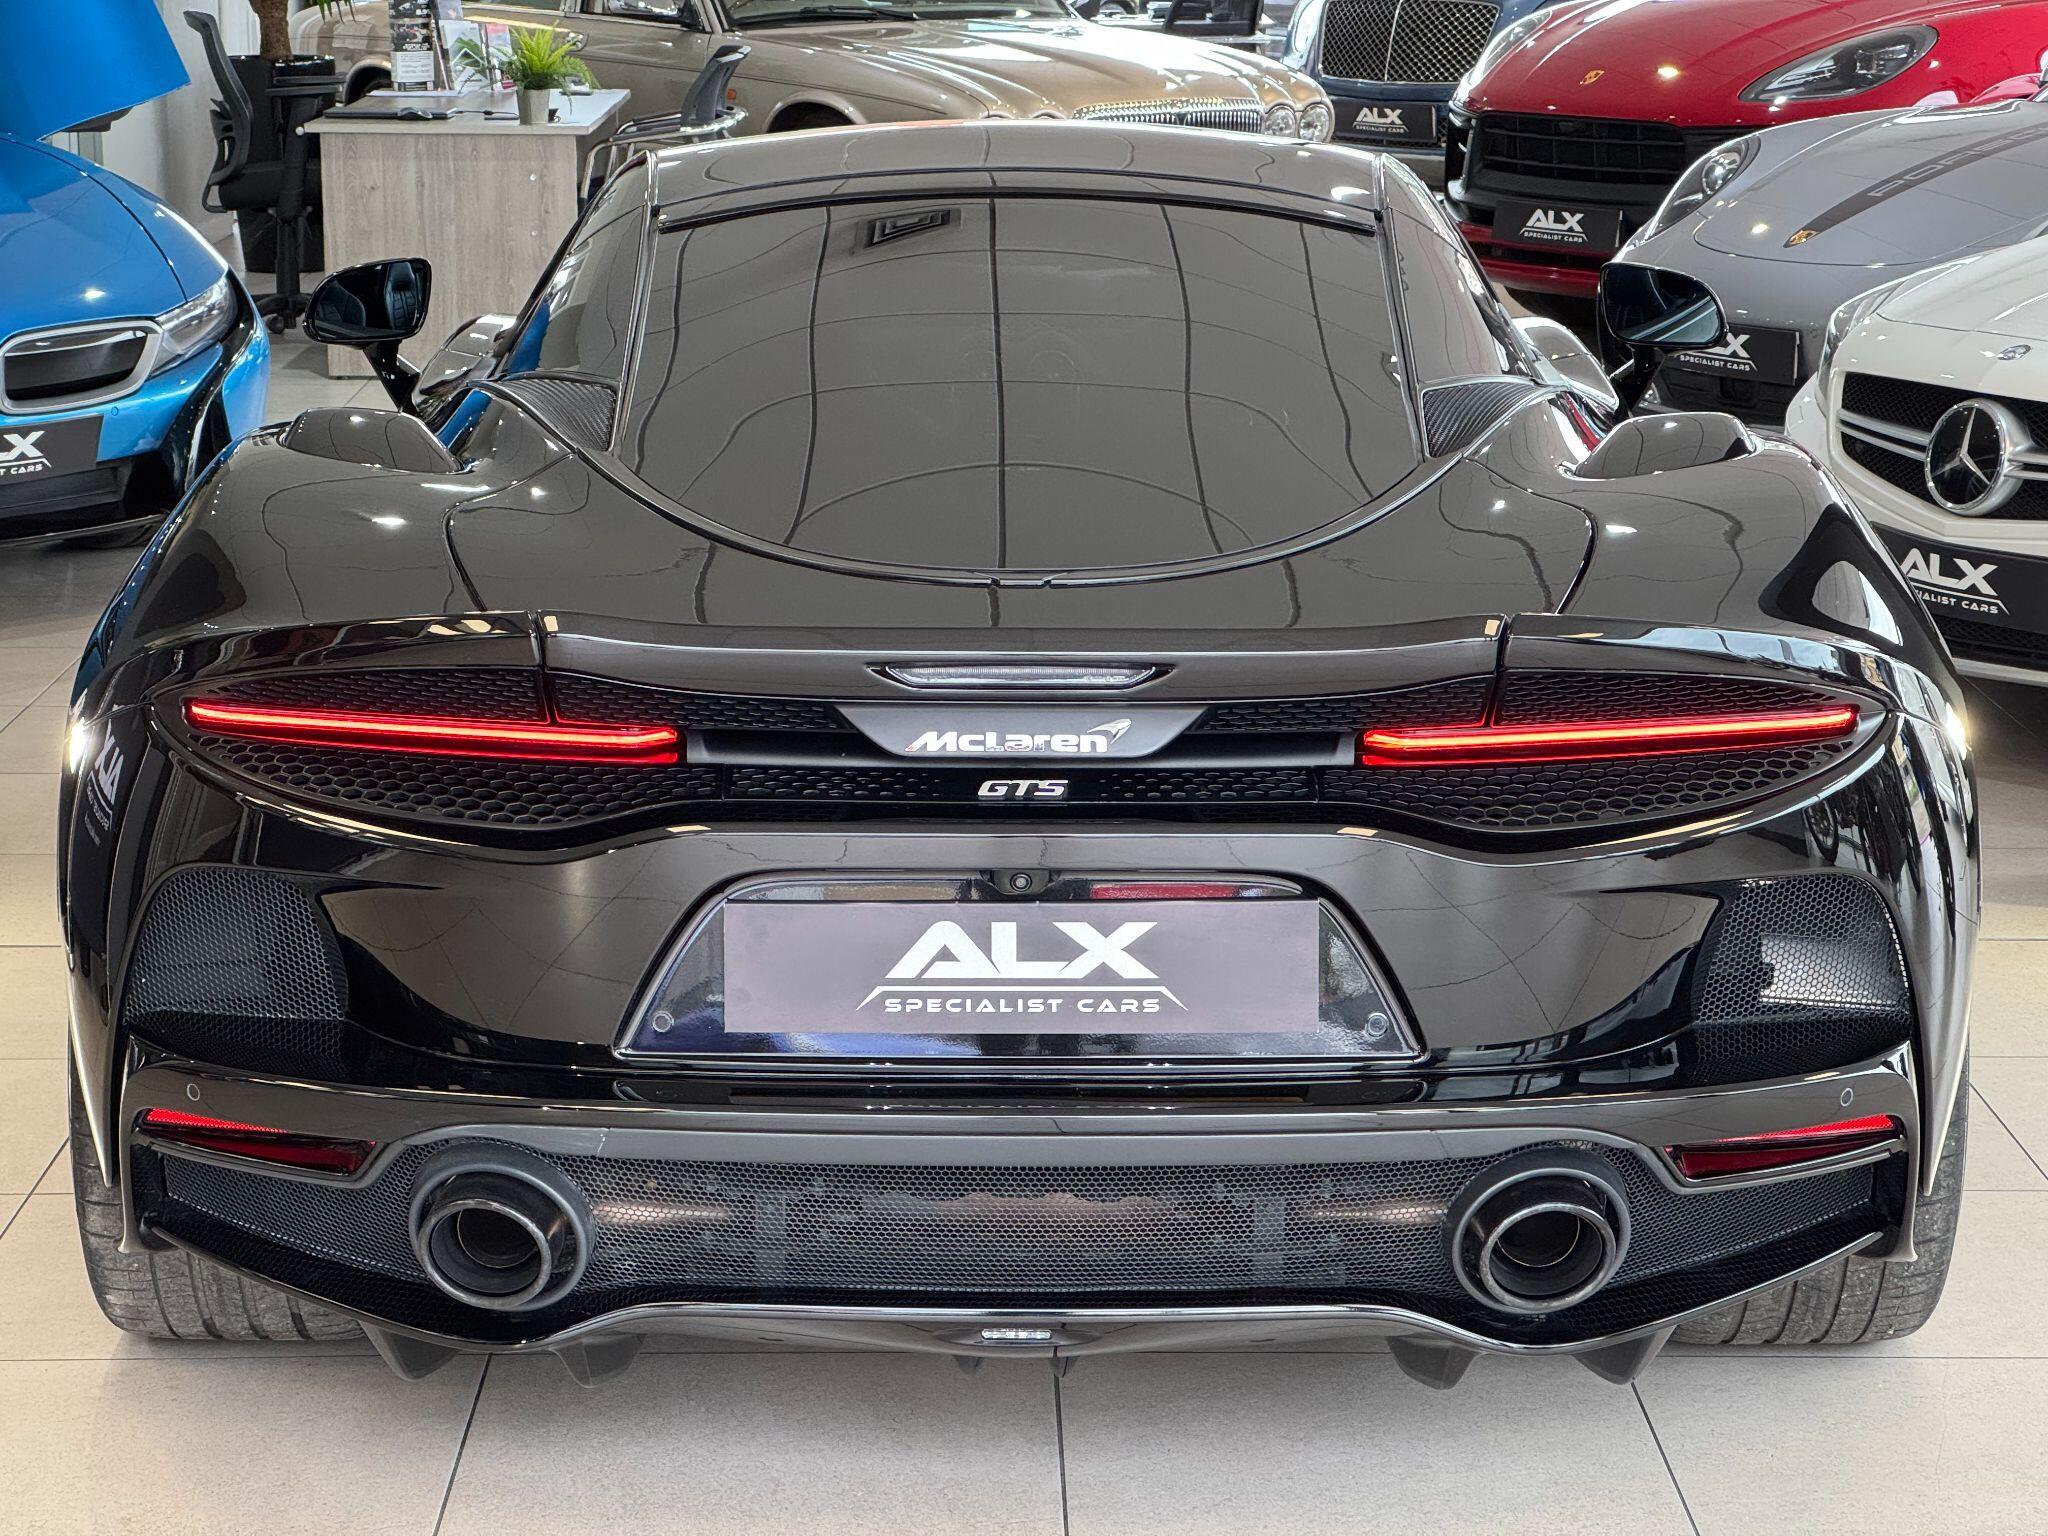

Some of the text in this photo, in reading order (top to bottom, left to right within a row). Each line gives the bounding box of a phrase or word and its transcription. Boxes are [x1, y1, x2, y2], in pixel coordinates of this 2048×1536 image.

[1355, 107, 1404, 125] ALX
[1867, 127, 2048, 197] PORSC
[1525, 208, 1585, 232] ALX
[1523, 231, 1562, 240] SPECIALIST
[1680, 354, 1751, 372] SPECIALIST CARS
[10, 463, 43, 475] CARS
[1900, 548, 2000, 597] ALX
[1915, 589, 1999, 614] IALIST CARS
[905, 731, 1108, 753] McLaren
[977, 779, 1069, 798] GTS
[885, 920, 1160, 979] ALX
[884, 998, 1161, 1013] SPECIALIST CARS
